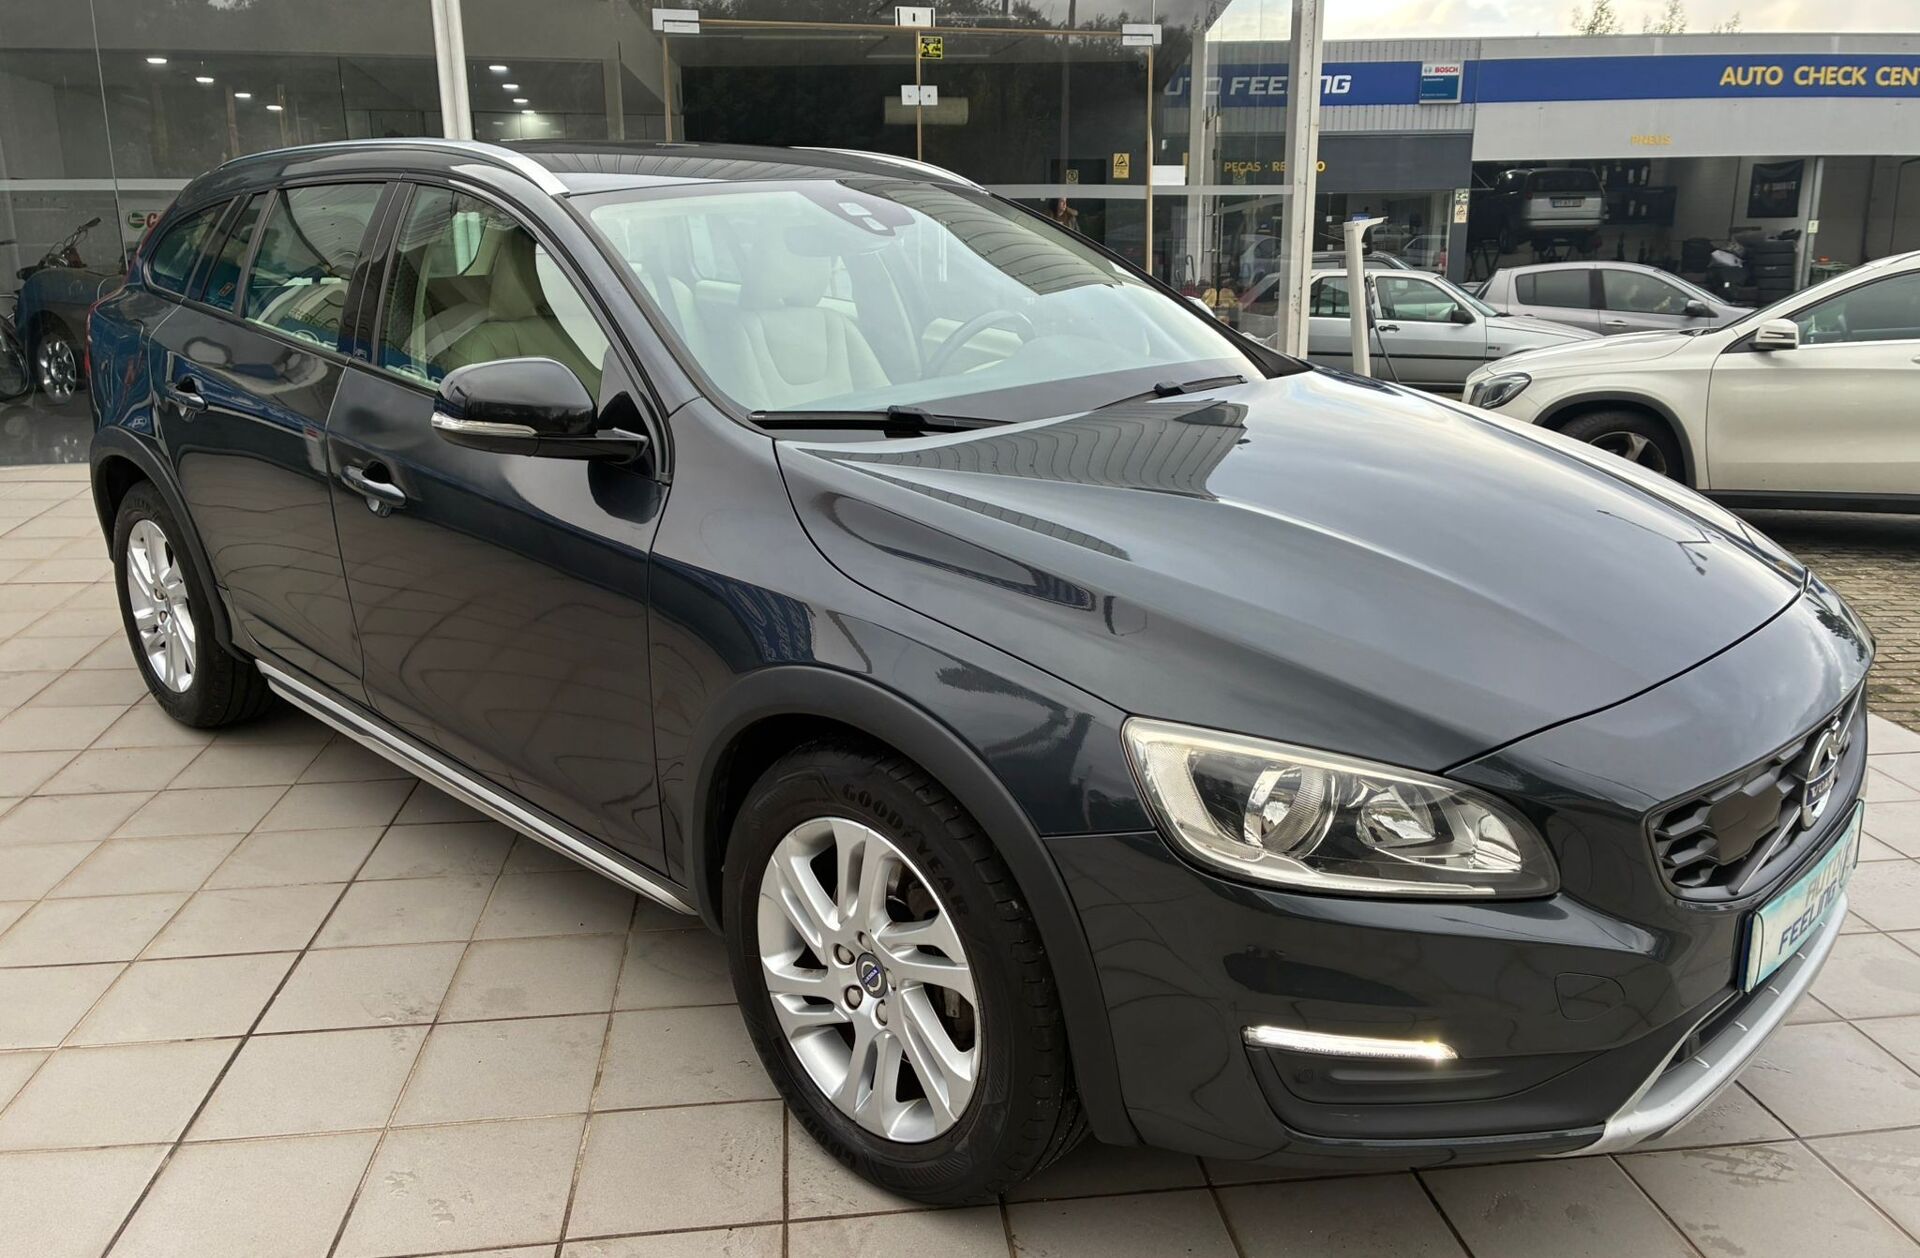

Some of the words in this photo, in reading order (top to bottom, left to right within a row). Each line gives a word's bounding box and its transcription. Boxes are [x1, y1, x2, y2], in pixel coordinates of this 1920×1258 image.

[1719, 66, 1784, 87] AUTO
[1793, 66, 1867, 87] CHECK
[1631, 134, 1672, 145] PNEUS
[1223, 161, 1261, 173] PEÇAS
[1778, 877, 1837, 955] FEELING
